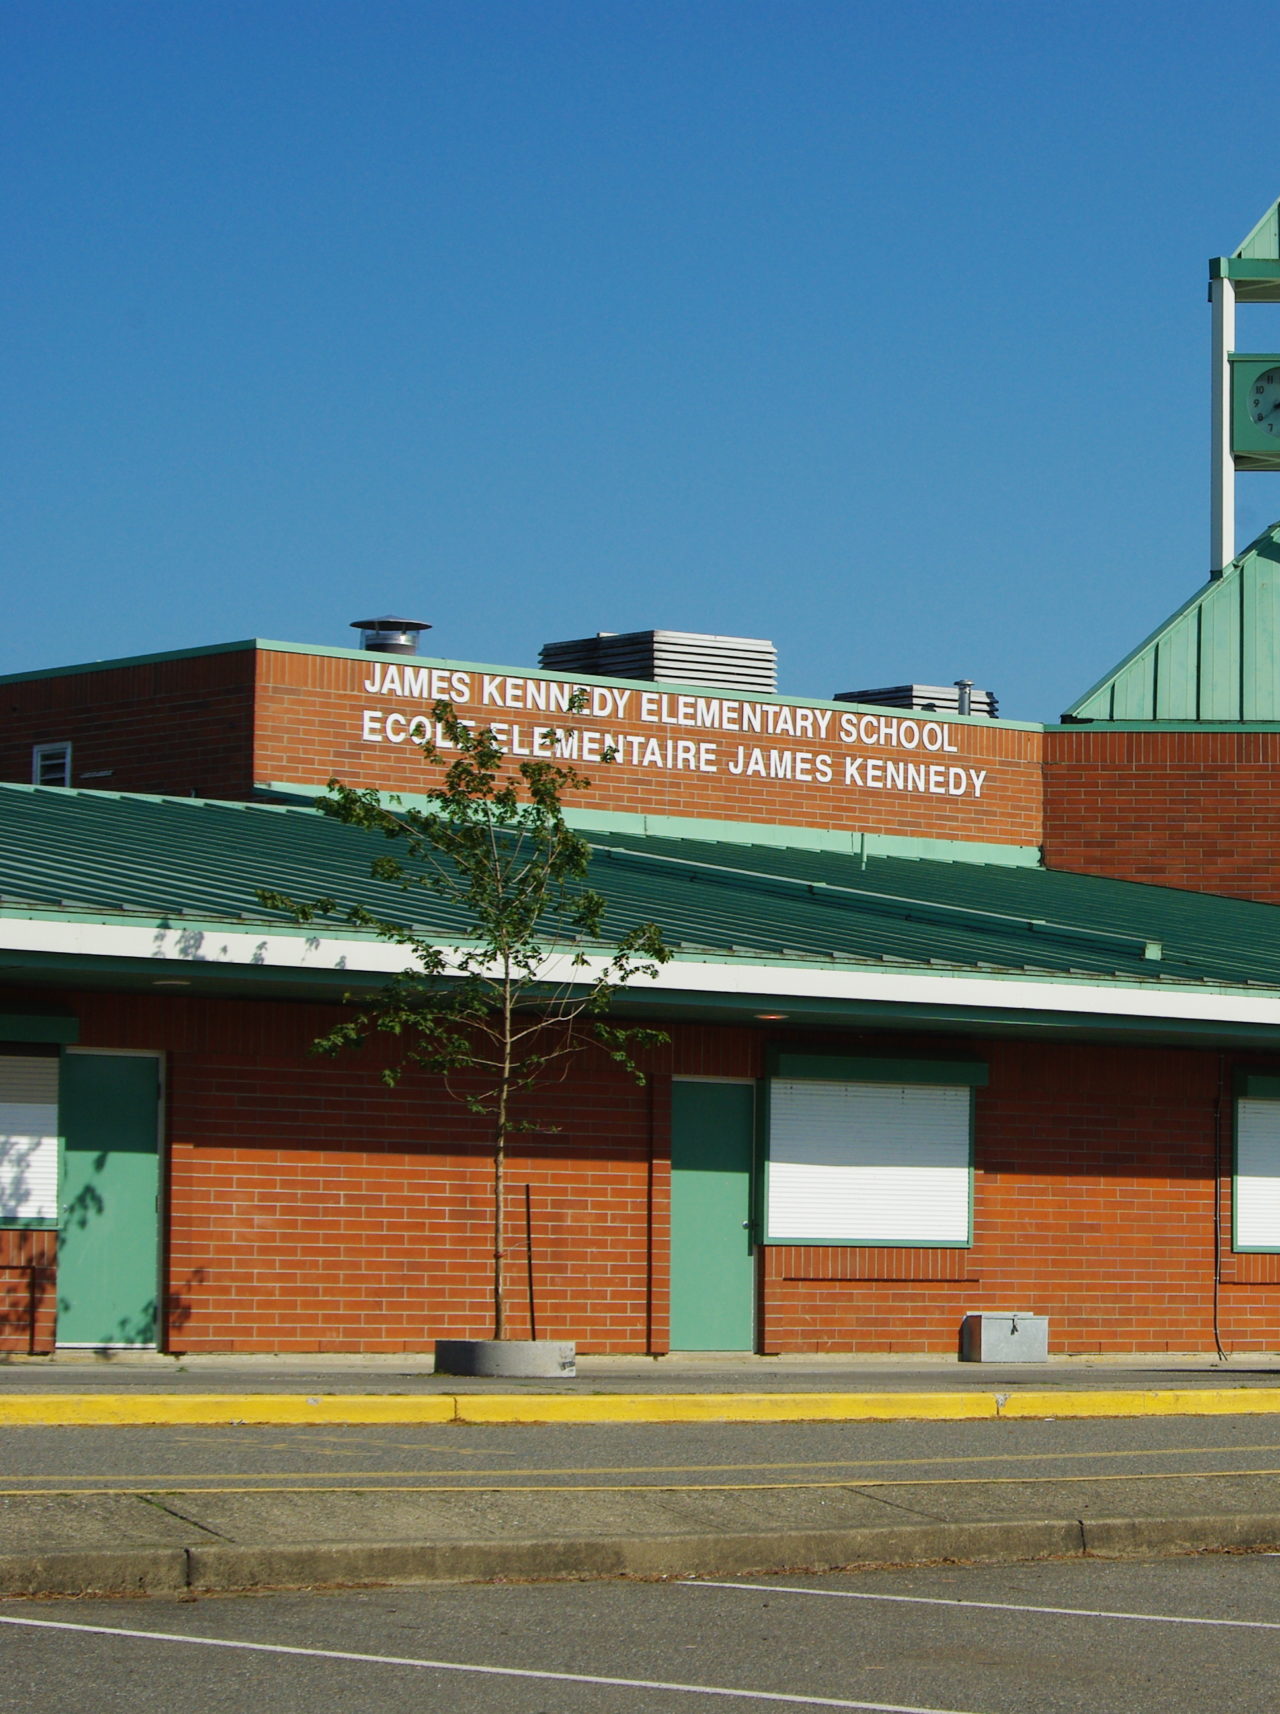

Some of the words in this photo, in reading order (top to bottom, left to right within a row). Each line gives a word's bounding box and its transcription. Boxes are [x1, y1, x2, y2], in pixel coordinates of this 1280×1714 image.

[1267, 376, 1274, 384] 11
[1256, 386, 1265, 394] 10
[1254, 400, 1260, 408] 9
[1268, 424, 1274, 432] 7
[364, 662, 472, 704] JAMES
[482, 675, 631, 719] KENNEDY
[640, 692, 832, 739] ELEMENTARY
[839, 713, 958, 753] SCHOOL
[490, 722, 718, 773] ELEMENTAIRE
[728, 745, 833, 784] JAMES
[845, 756, 987, 798] KENNEDY
